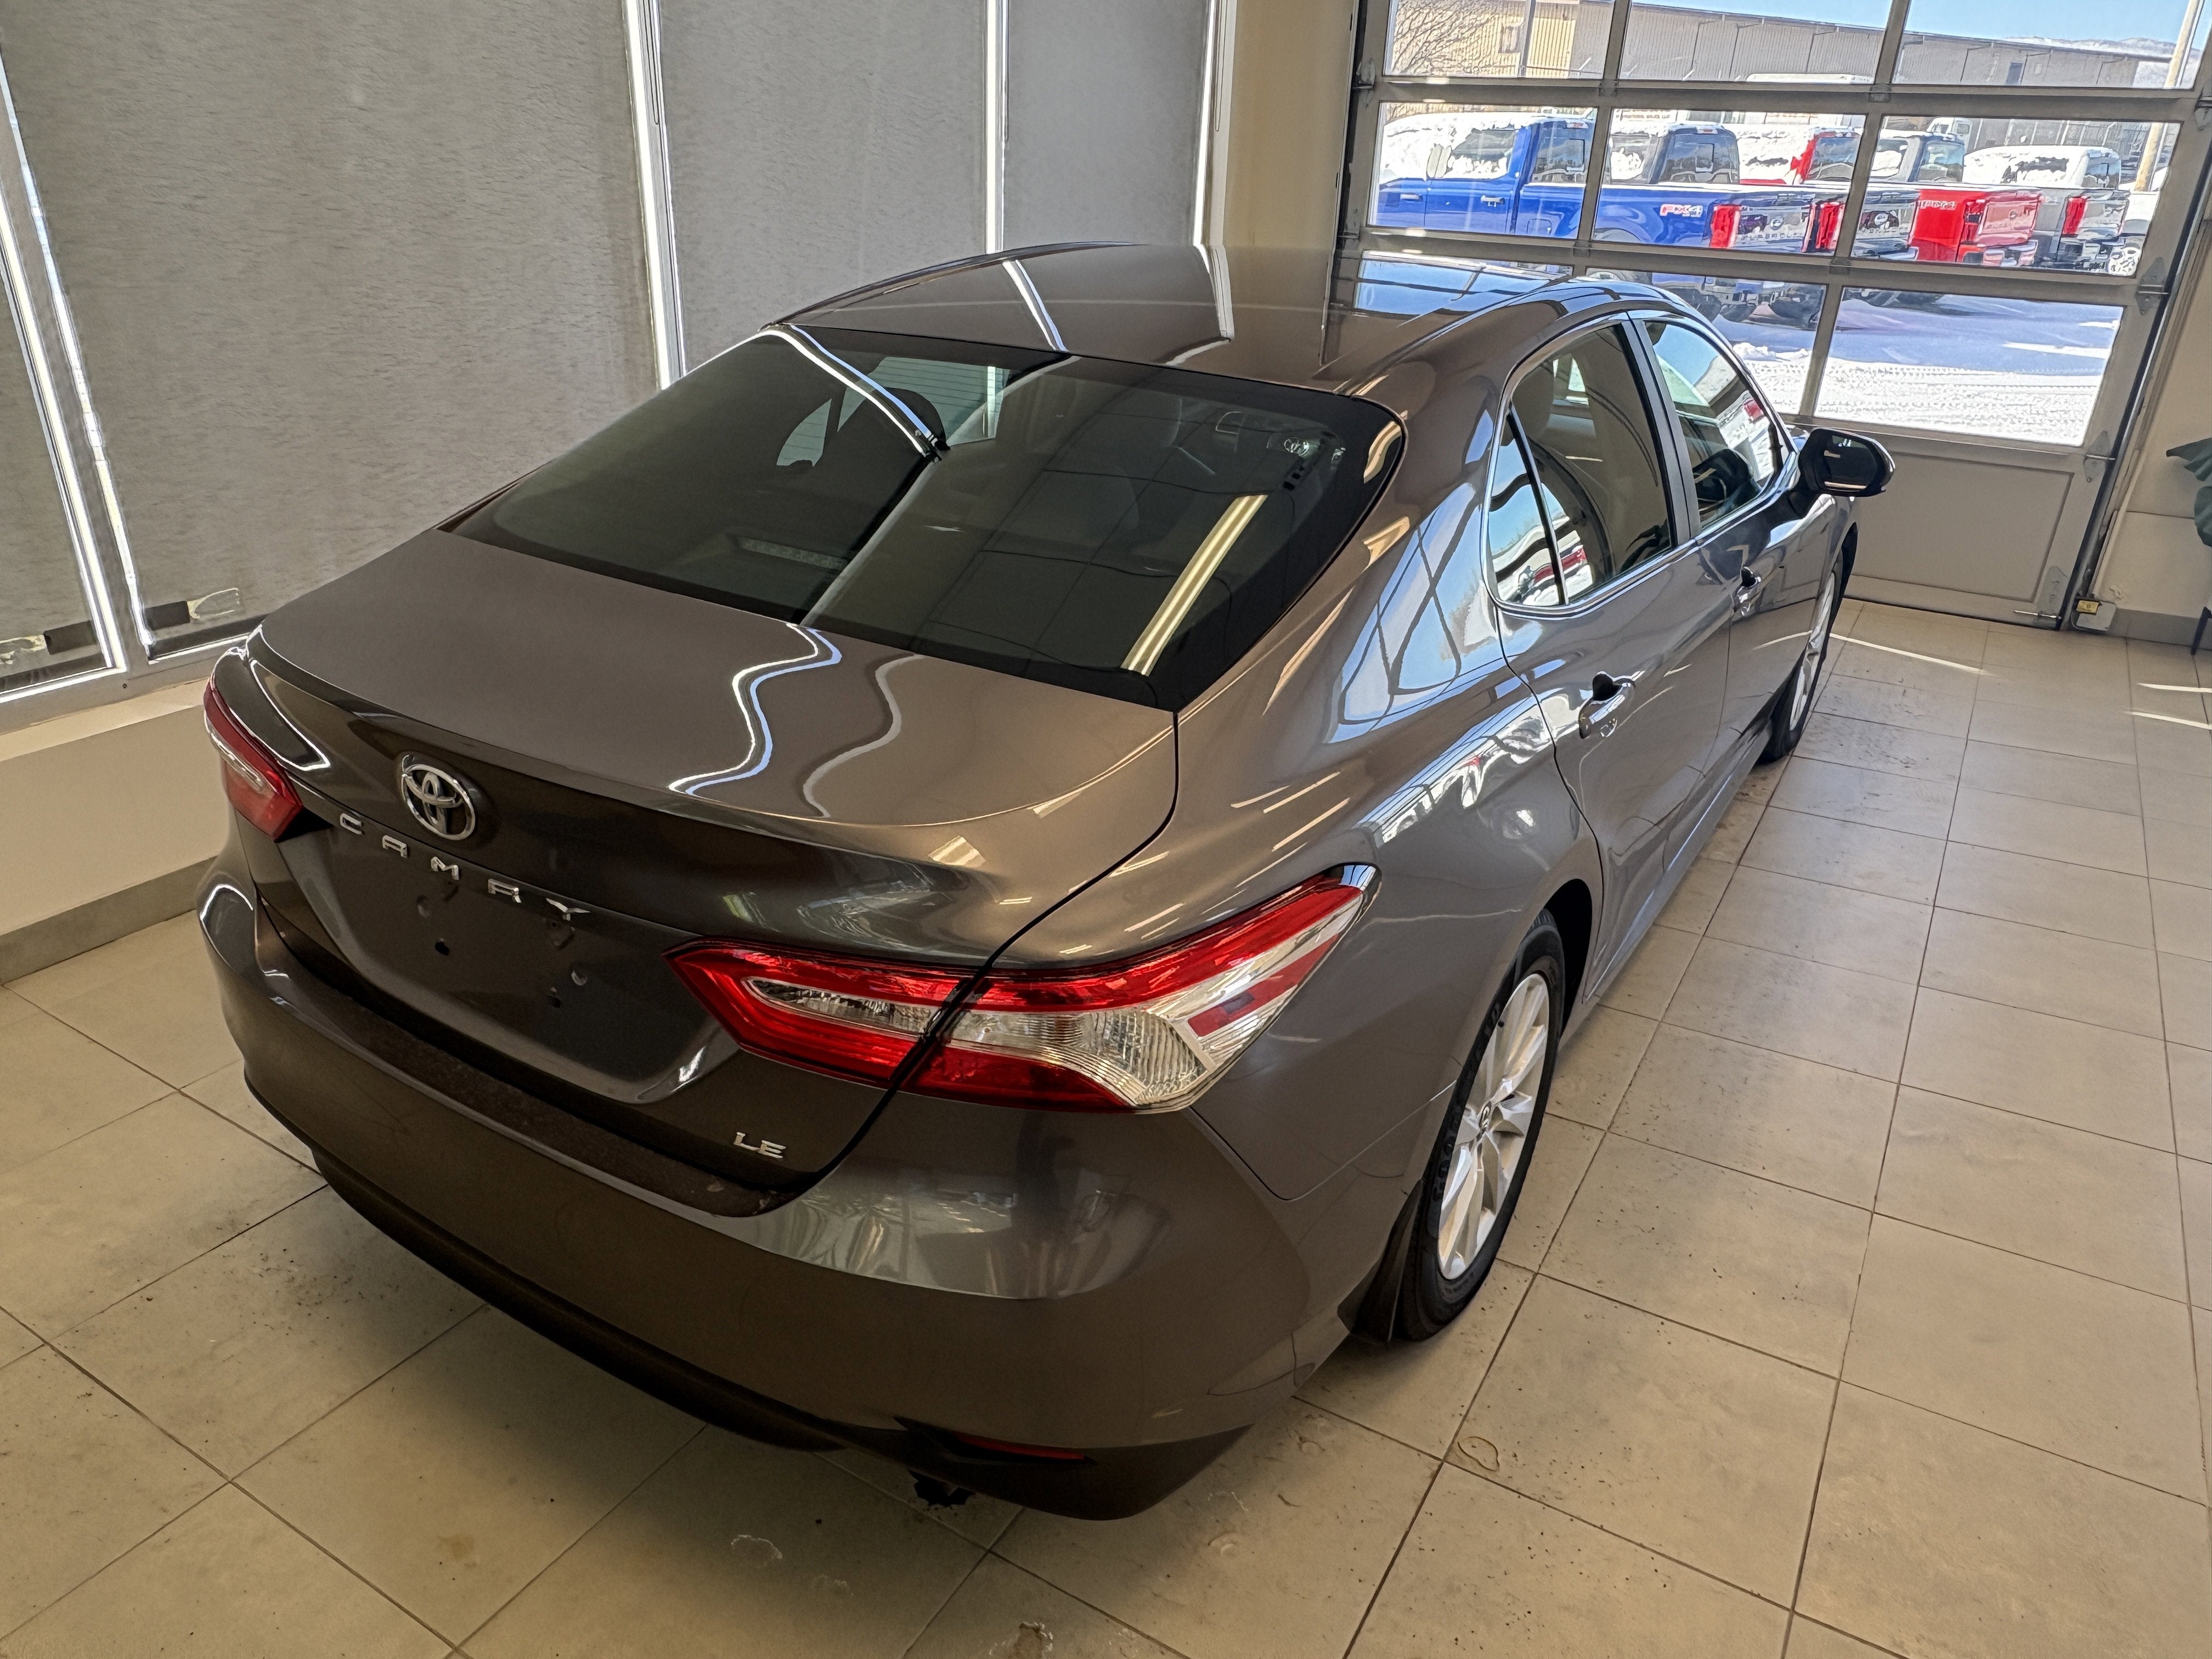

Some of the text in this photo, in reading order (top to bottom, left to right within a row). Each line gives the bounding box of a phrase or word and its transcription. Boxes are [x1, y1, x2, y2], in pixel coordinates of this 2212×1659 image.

[1660, 204, 1703, 218] FX4
[339, 812, 591, 921] CAMRY
[733, 1132, 786, 1159] LE
